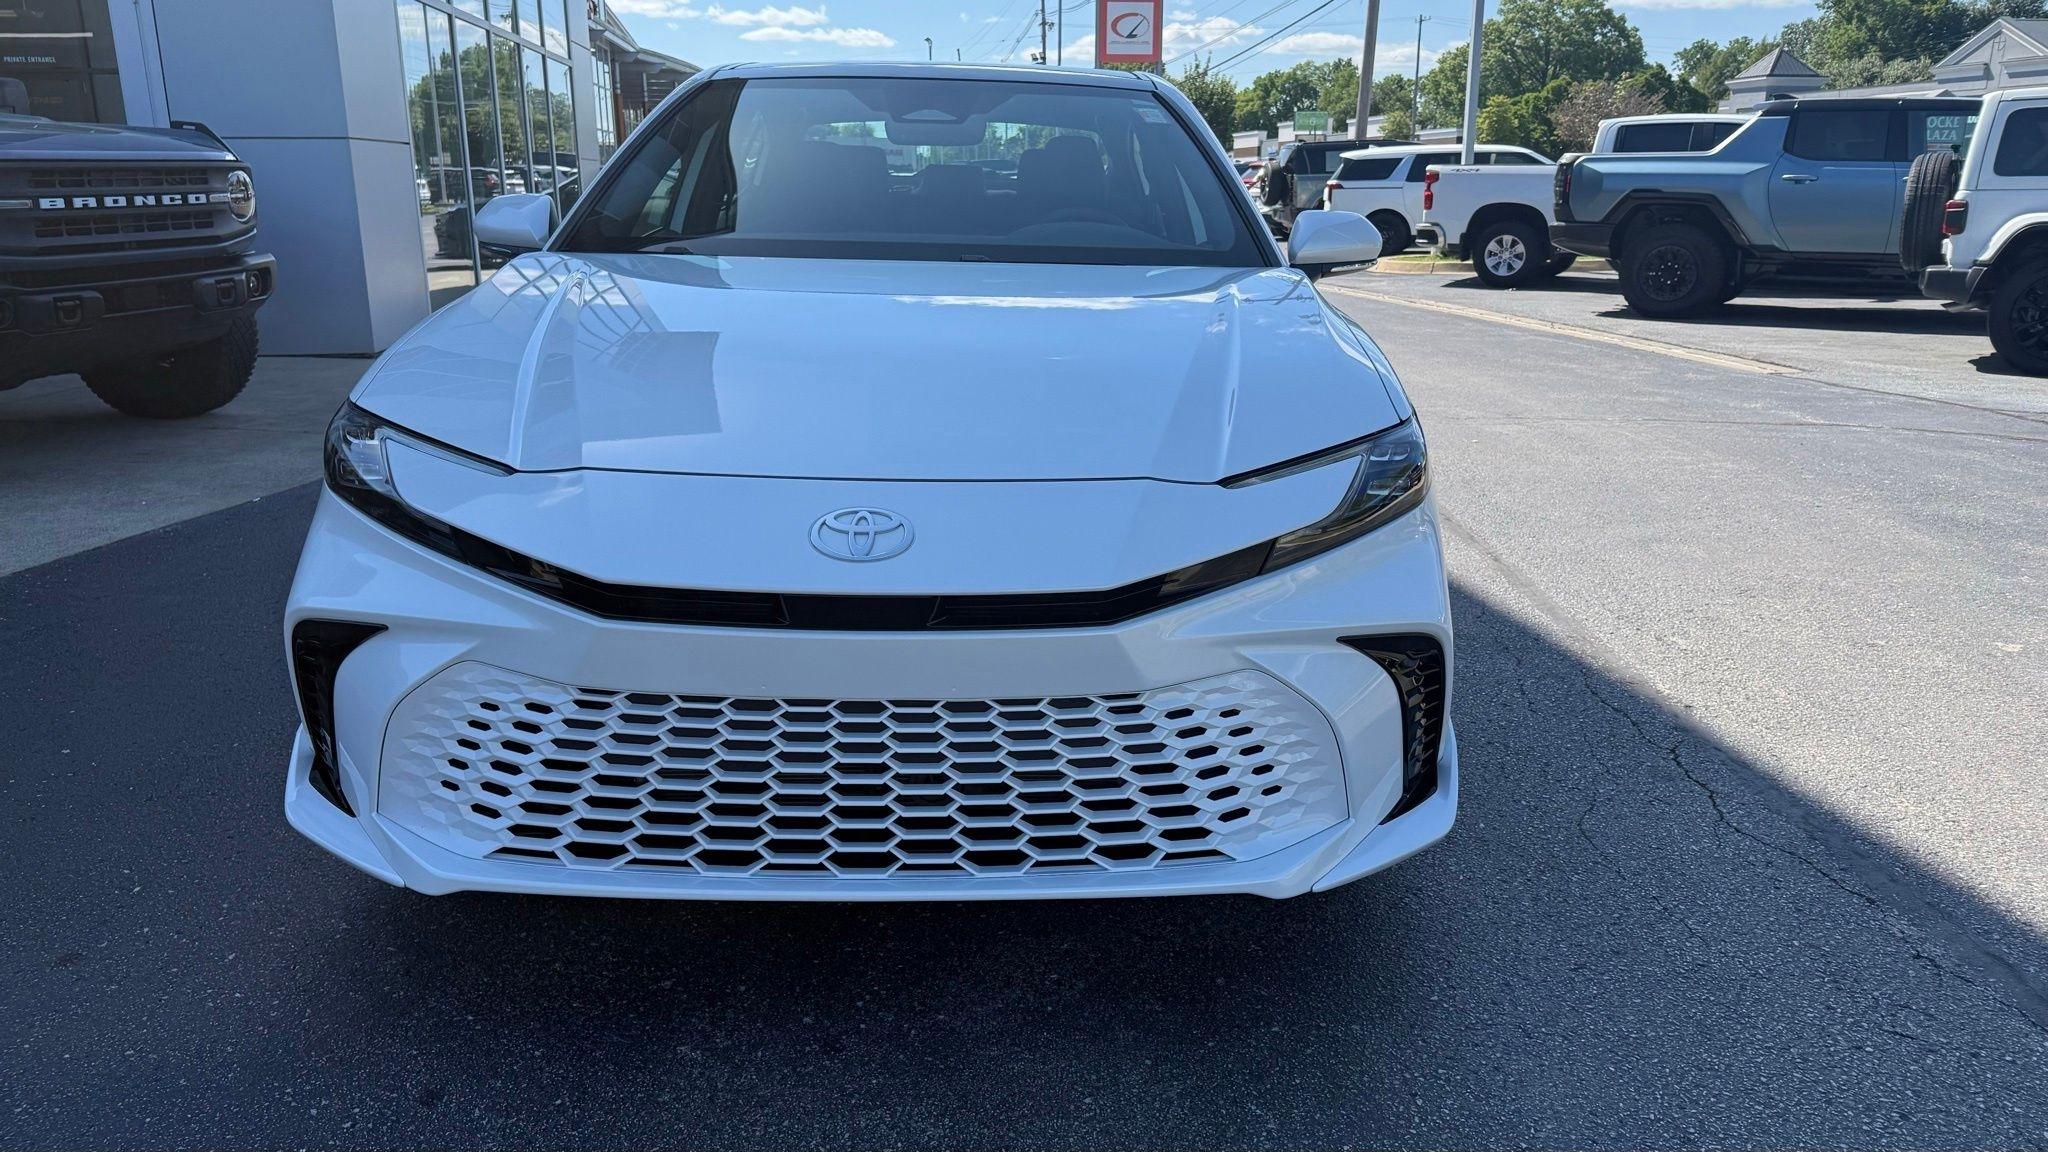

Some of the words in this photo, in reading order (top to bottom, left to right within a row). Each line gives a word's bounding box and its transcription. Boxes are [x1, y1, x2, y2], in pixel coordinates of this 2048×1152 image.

[27, 56, 56, 64] ENTRANCE
[1927, 116, 1961, 128] OCKE
[1927, 129, 1957, 141] LAZA
[38, 193, 208, 209] BRONCO
